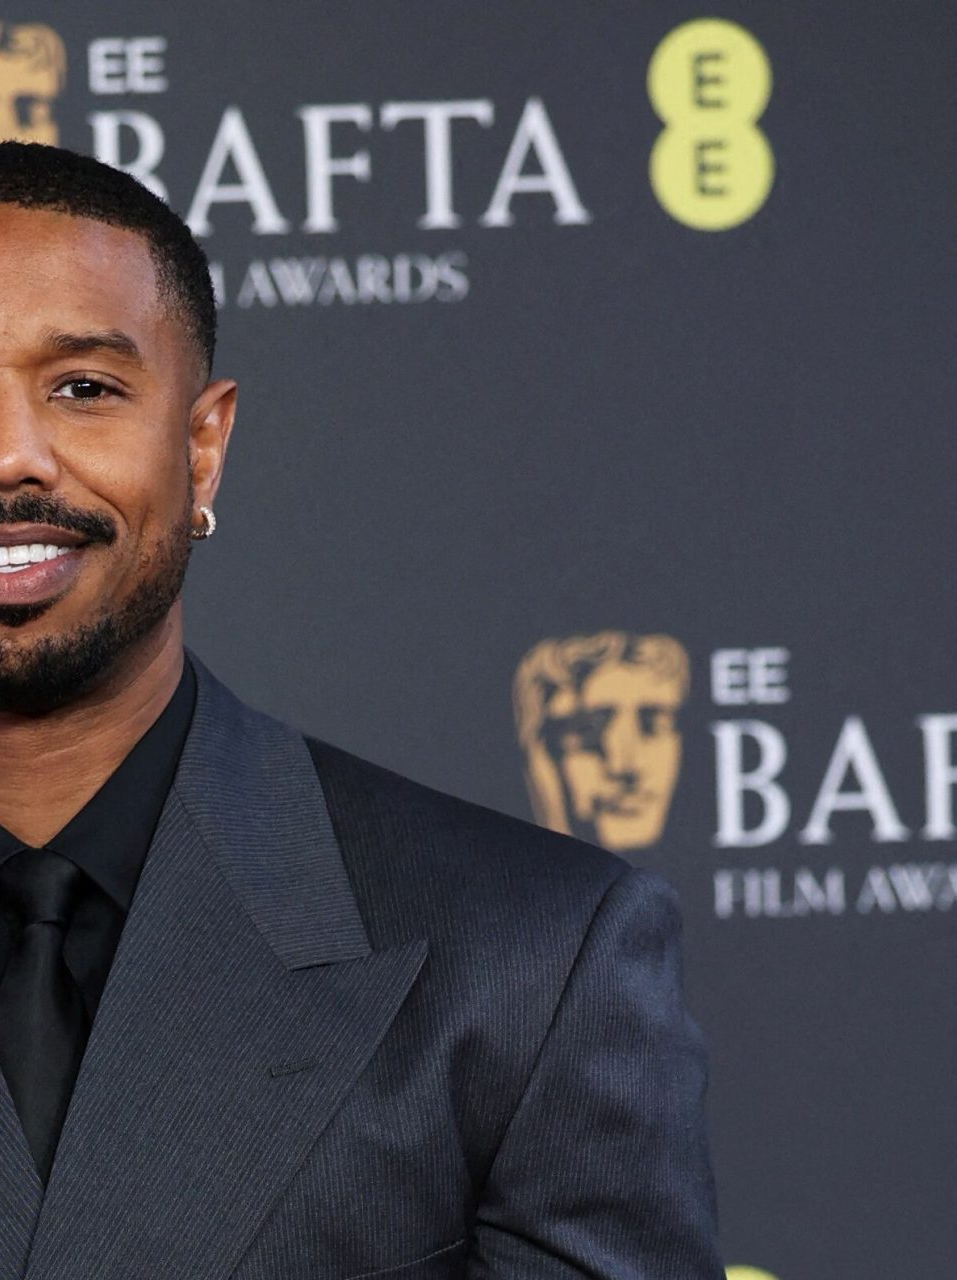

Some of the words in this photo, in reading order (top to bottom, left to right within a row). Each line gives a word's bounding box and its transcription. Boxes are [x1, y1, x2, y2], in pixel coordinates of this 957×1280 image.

[87, 37, 169, 95] EE
[238, 252, 470, 308] AWARDS
[710, 648, 791, 704] EE
[715, 868, 845, 917] FILM
